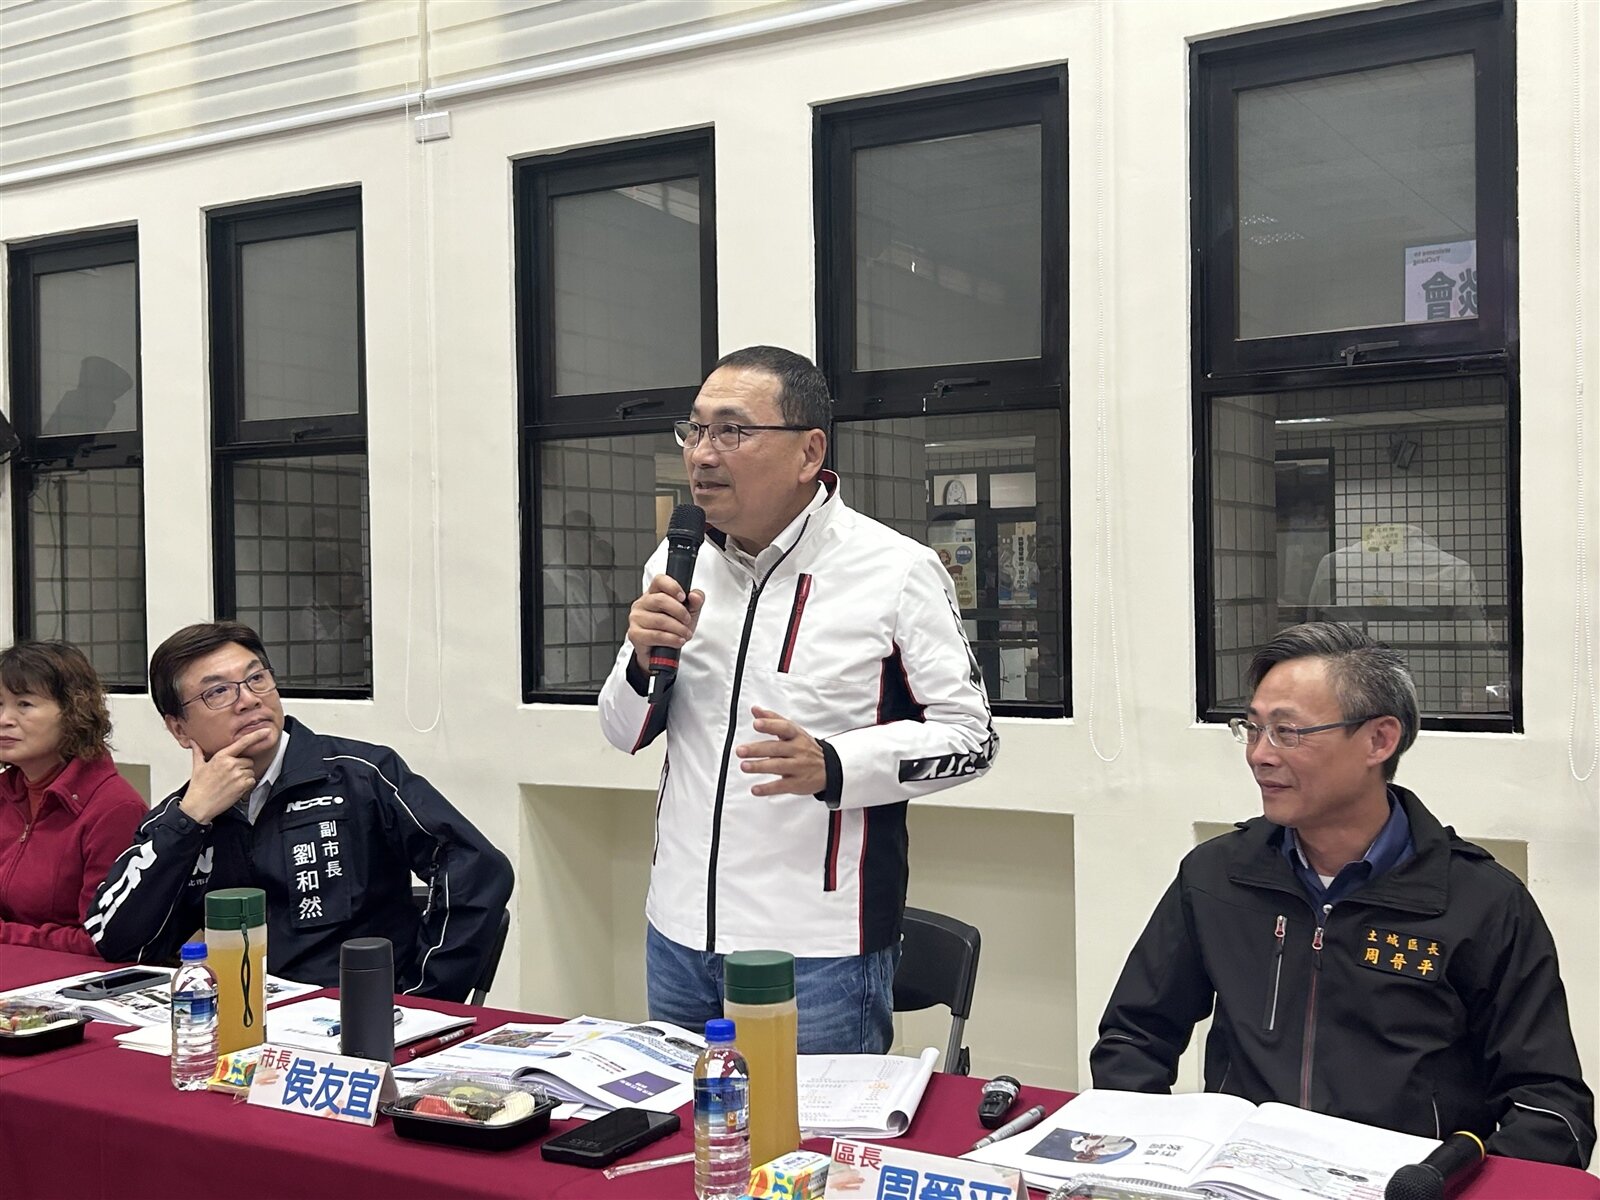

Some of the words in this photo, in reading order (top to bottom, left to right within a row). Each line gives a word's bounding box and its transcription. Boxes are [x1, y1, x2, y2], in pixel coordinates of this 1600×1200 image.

[318, 820, 343, 878] 副市長
[292, 841, 323, 920] 劉和然
[1367, 929, 1440, 956] 土城區長
[1364, 947, 1434, 976] 周晉平
[259, 1047, 293, 1072] 市長
[282, 1056, 381, 1120] 侯友宜
[834, 1141, 883, 1171] 區長
